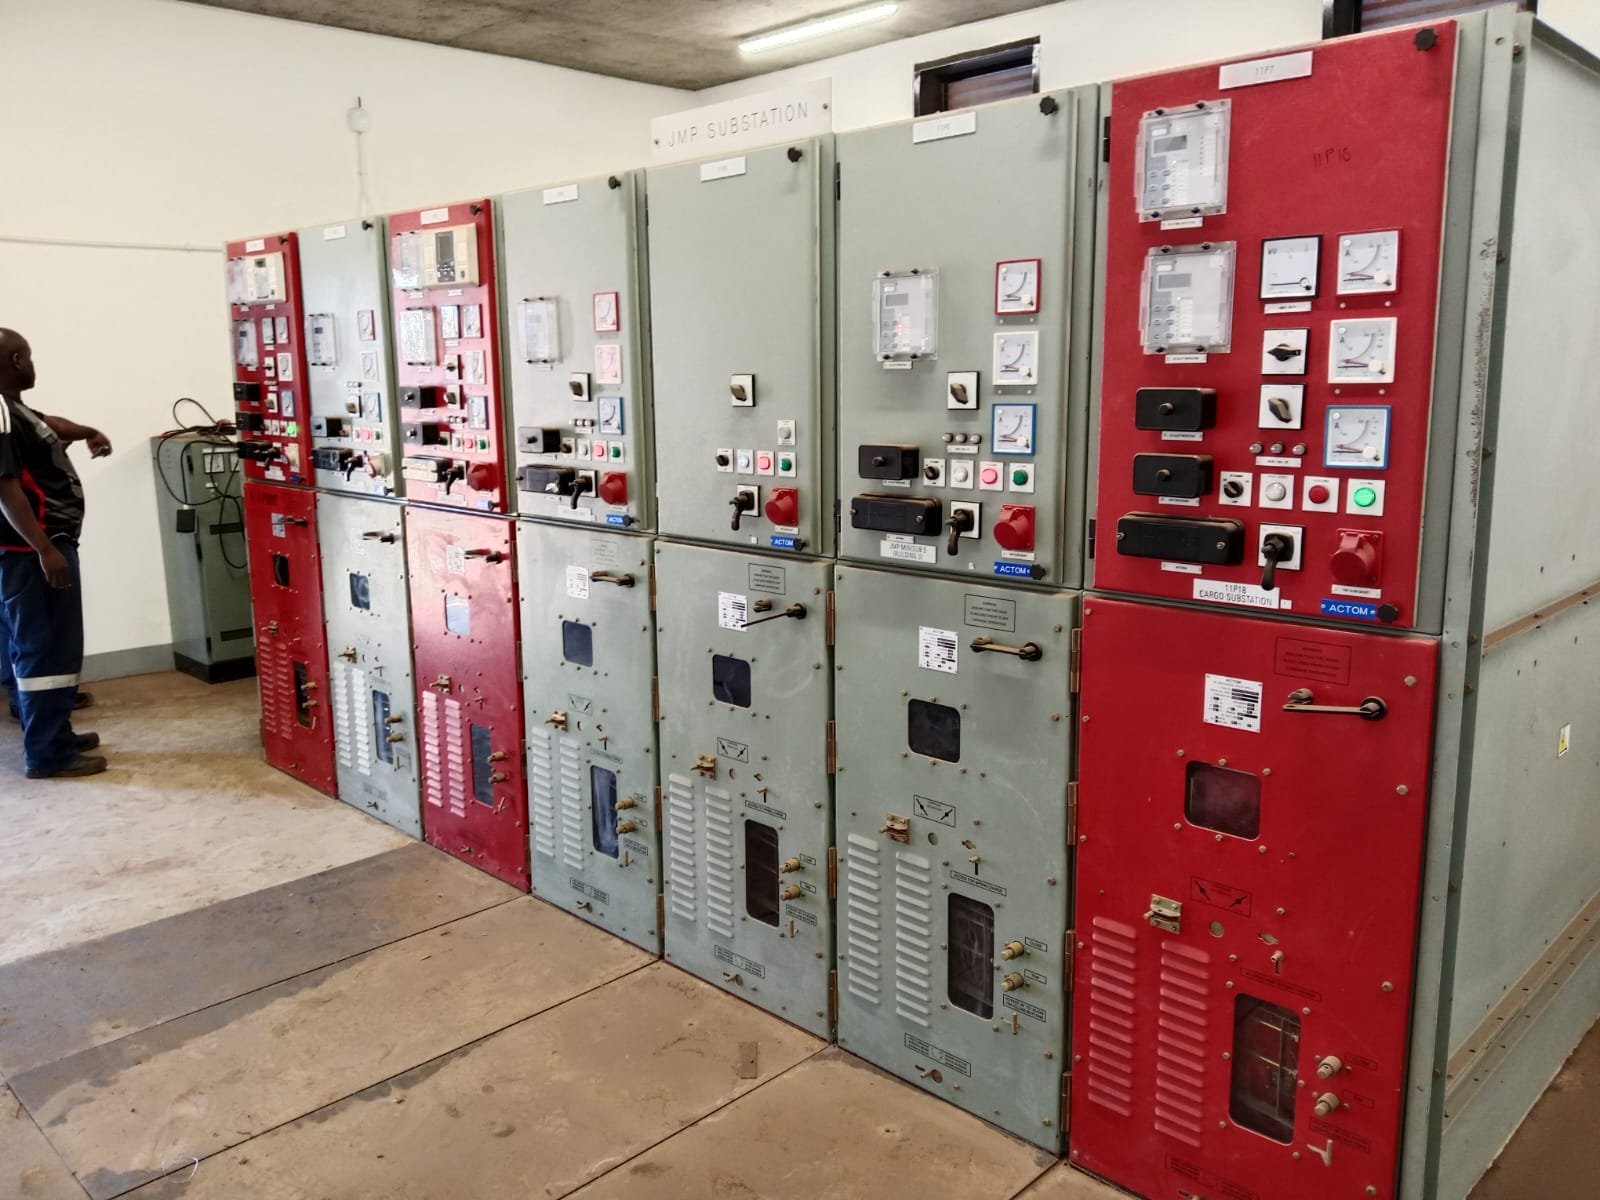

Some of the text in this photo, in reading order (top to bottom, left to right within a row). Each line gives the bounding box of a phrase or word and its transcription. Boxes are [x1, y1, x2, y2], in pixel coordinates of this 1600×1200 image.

[667, 102, 809, 148] JMP SUBSTATION
[774, 538, 794, 546] ACTOM
[999, 564, 1027, 574] ACTOM
[1199, 590, 1273, 606] CARGO SUBSTATION
[1328, 603, 1369, 616] ACTOM
